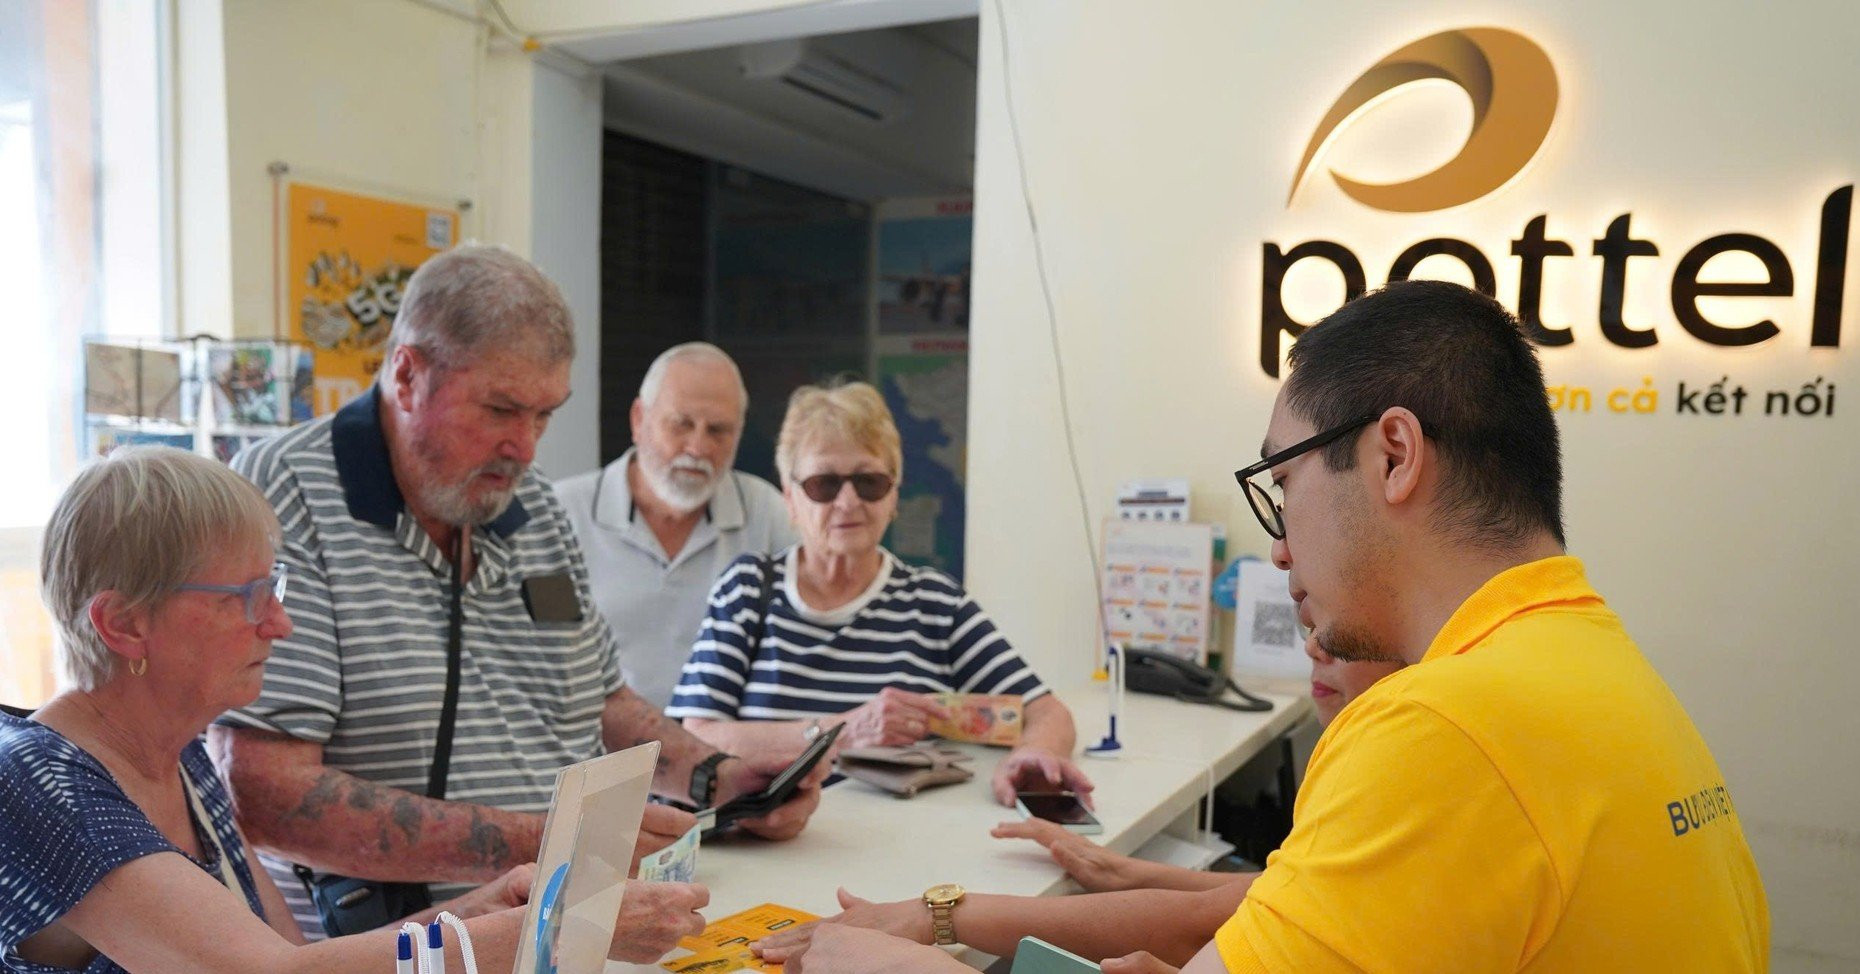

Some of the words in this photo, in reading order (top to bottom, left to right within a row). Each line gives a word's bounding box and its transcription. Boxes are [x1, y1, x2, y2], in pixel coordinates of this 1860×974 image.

[1546, 384, 1592, 413] ơn
[1607, 375, 1659, 414] cả
[1676, 375, 1748, 415] kết
[1765, 376, 1836, 417] nối
